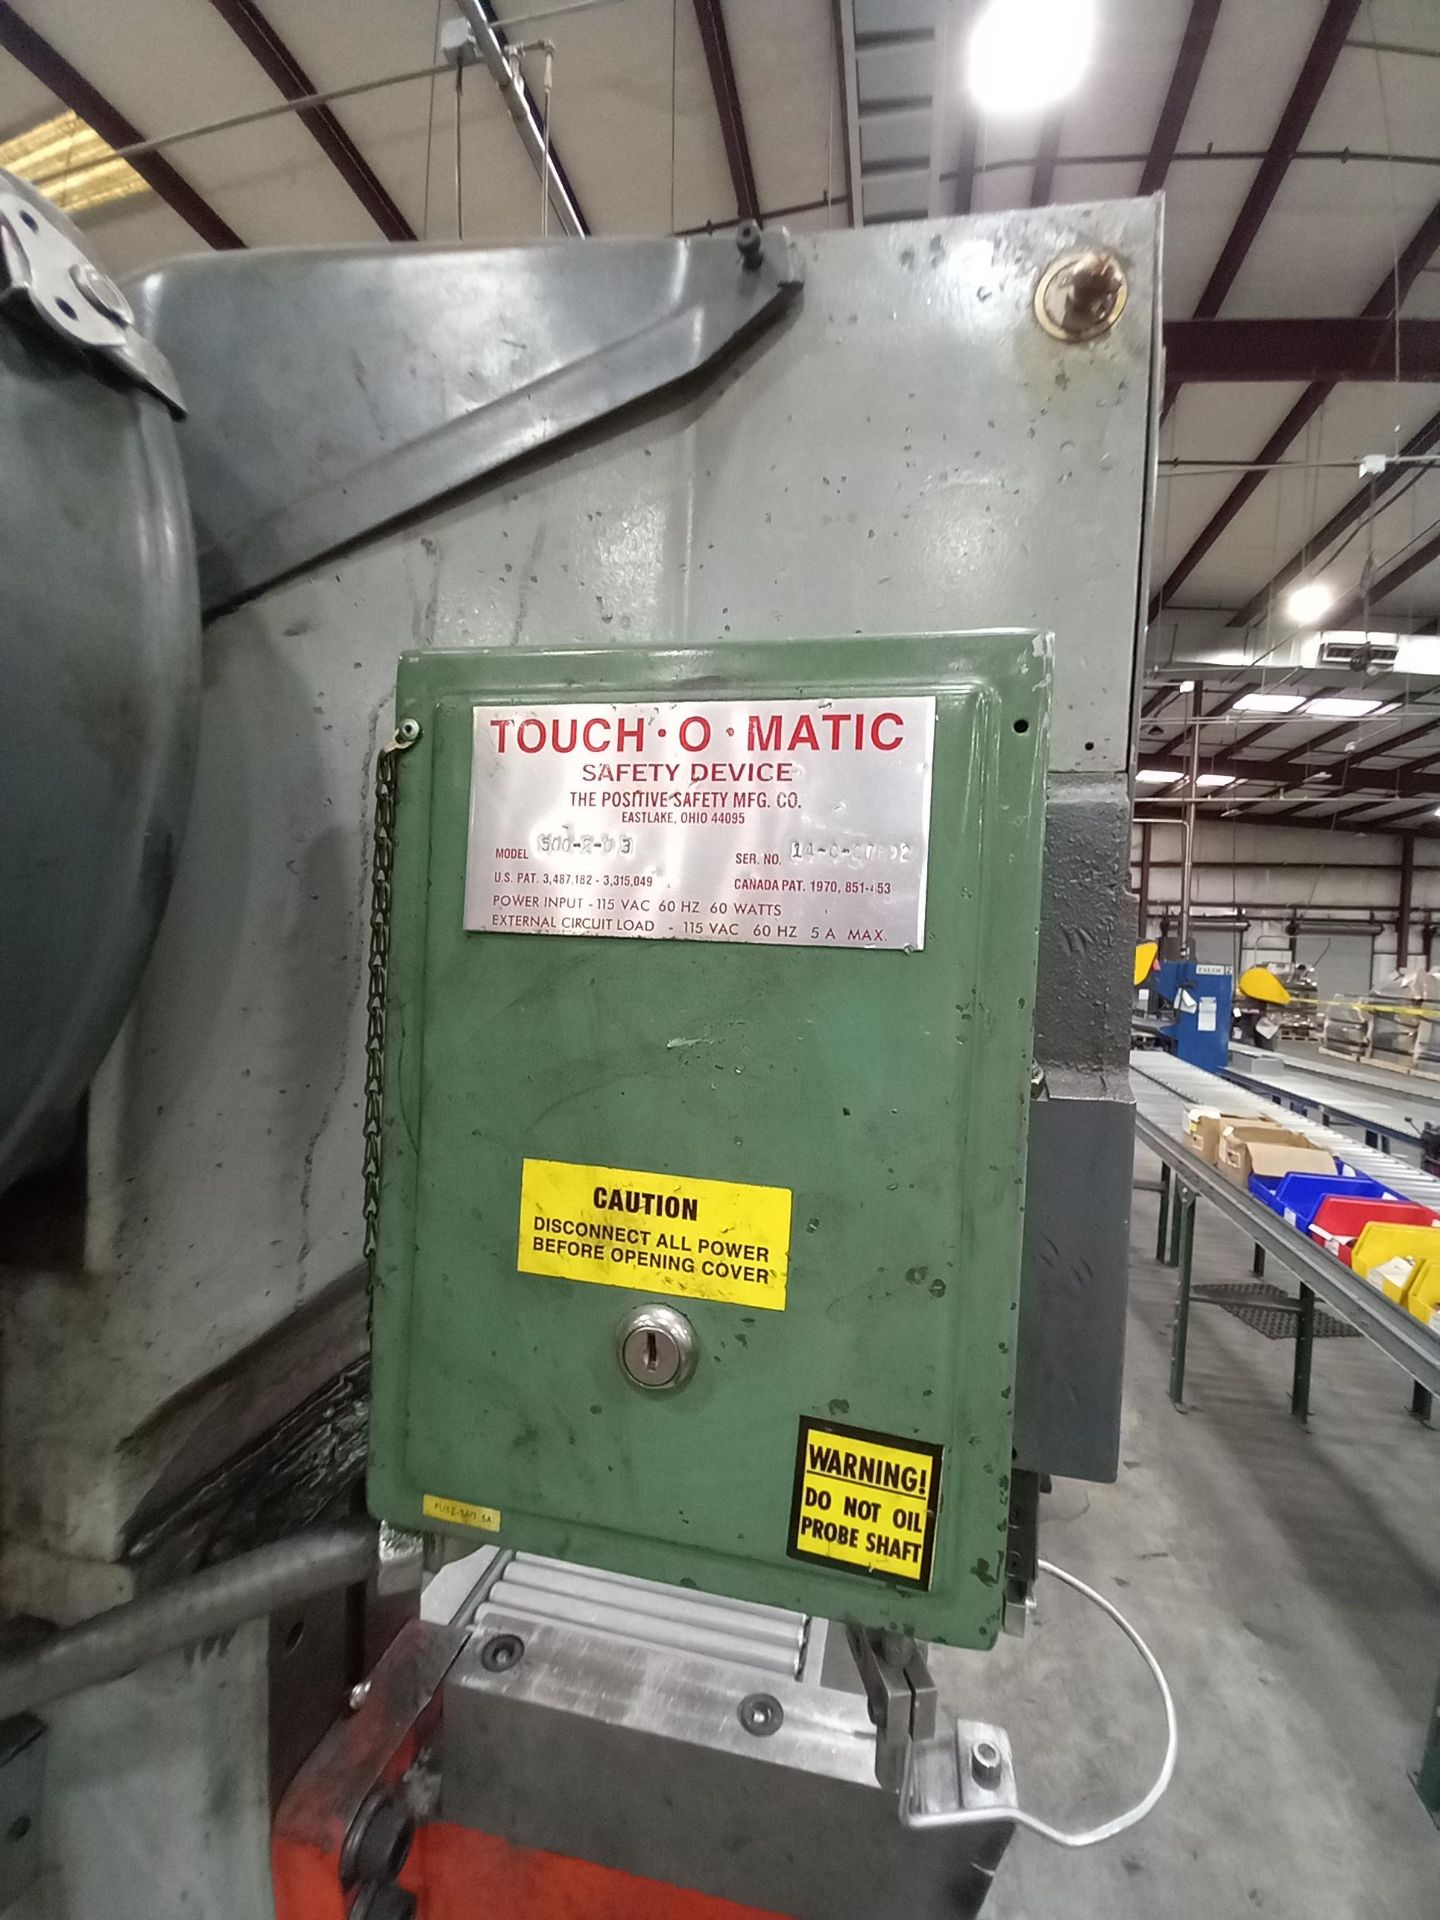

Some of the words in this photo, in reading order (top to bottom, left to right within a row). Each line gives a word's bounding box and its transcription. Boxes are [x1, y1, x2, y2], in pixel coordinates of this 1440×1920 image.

[490, 717, 645, 753] TOUCH
[747, 712, 904, 751] MATIC
[582, 763, 680, 782] SAFETY
[691, 763, 793, 782] DEVICE
[570, 791, 596, 807] THE
[601, 791, 668, 808] POSITIVE
[674, 791, 728, 808] SAFETY
[733, 792, 770, 808] MFG.
[777, 792, 802, 809] CO.
[622, 812, 677, 825] EASTLAKE,
[681, 812, 708, 824] OHIO
[711, 812, 745, 824] 44095
[495, 848, 528, 860] MODEL
[735, 852, 759, 864] SER.
[763, 853, 782, 865] NO.
[494, 872, 513, 883] U.S.
[517, 872, 538, 884] PAT.
[543, 873, 592, 886] 3,487,182
[603, 875, 653, 887] 3,315,049
[734, 879, 779, 891] CANADA
[782, 880, 805, 892] PAT.
[810, 881, 841, 894] 1970,
[493, 895, 540, 908] POWER
[544, 897, 583, 909] INPUT
[597, 898, 615, 911] 115
[620, 899, 650, 911] VAC
[658, 900, 676, 913] 60
[681, 901, 700, 914] HZ
[710, 902, 727, 915] 60
[734, 903, 782, 916] WATTS
[492, 914, 556, 928] EXTERNAL
[561, 917, 613, 931] CIRCUIT
[617, 919, 655, 932] LOAD
[683, 921, 703, 934] 115
[709, 922, 739, 935] VAC
[753, 924, 771, 937] 60
[777, 925, 798, 938] HZ
[810, 926, 820, 939] 5
[825, 927, 836, 940] A
[847, 929, 887, 942] MAX.
[593, 1186, 698, 1222] CAUTION
[534, 1216, 650, 1246] DISCONNECT
[656, 1233, 692, 1252] ALL
[697, 1239, 769, 1263] POWER
[533, 1237, 604, 1260] BEFORE
[610, 1248, 695, 1274] OPENING
[701, 1261, 769, 1284] COVER
[809, 1444, 927, 1495] WARNING!
[805, 1487, 831, 1510] DO
[844, 1496, 881, 1523] NOT
[893, 1508, 922, 1533] OIL
[801, 1516, 859, 1548] PROBE
[866, 1532, 922, 1563] SHAFT
